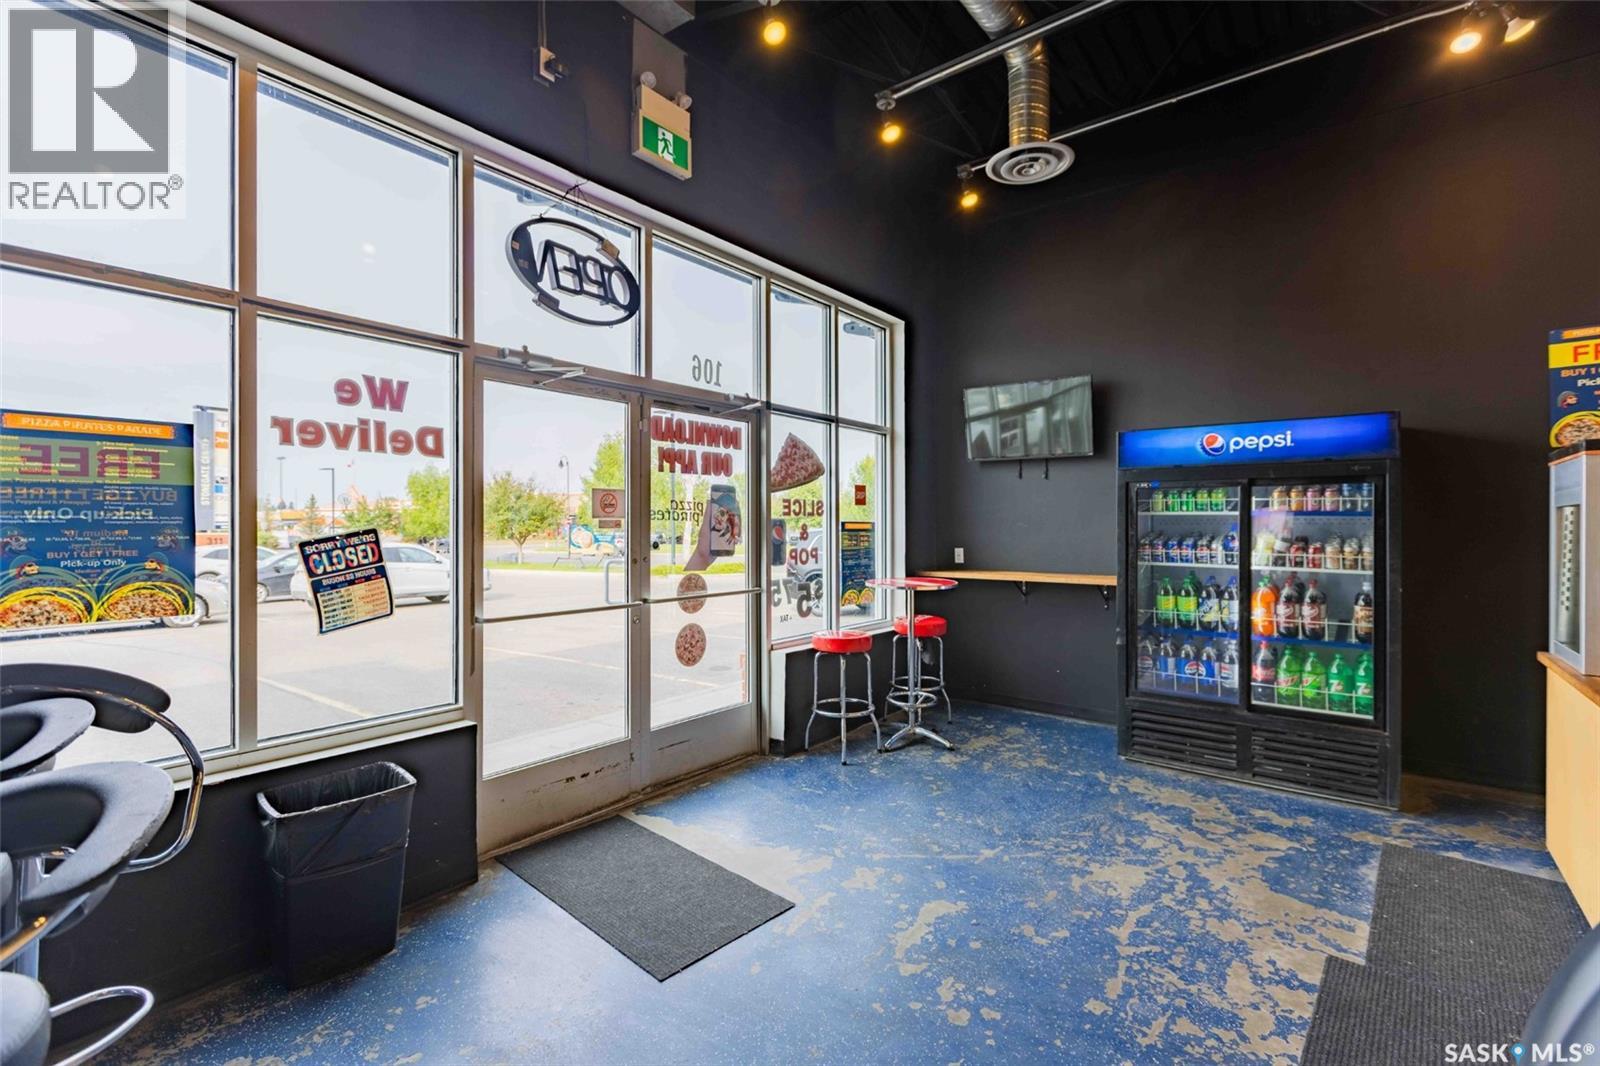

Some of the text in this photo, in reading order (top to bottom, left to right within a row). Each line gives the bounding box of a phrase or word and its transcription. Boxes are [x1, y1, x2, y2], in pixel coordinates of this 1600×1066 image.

[1560, 367, 1588, 378] BUY
[1230, 430, 1294, 453] pepsi
[112, 550, 139, 558] FREE
[304, 541, 342, 555] SORRY
[60, 558, 127, 569] Pick-up Only
[308, 543, 380, 575] CLOSED
